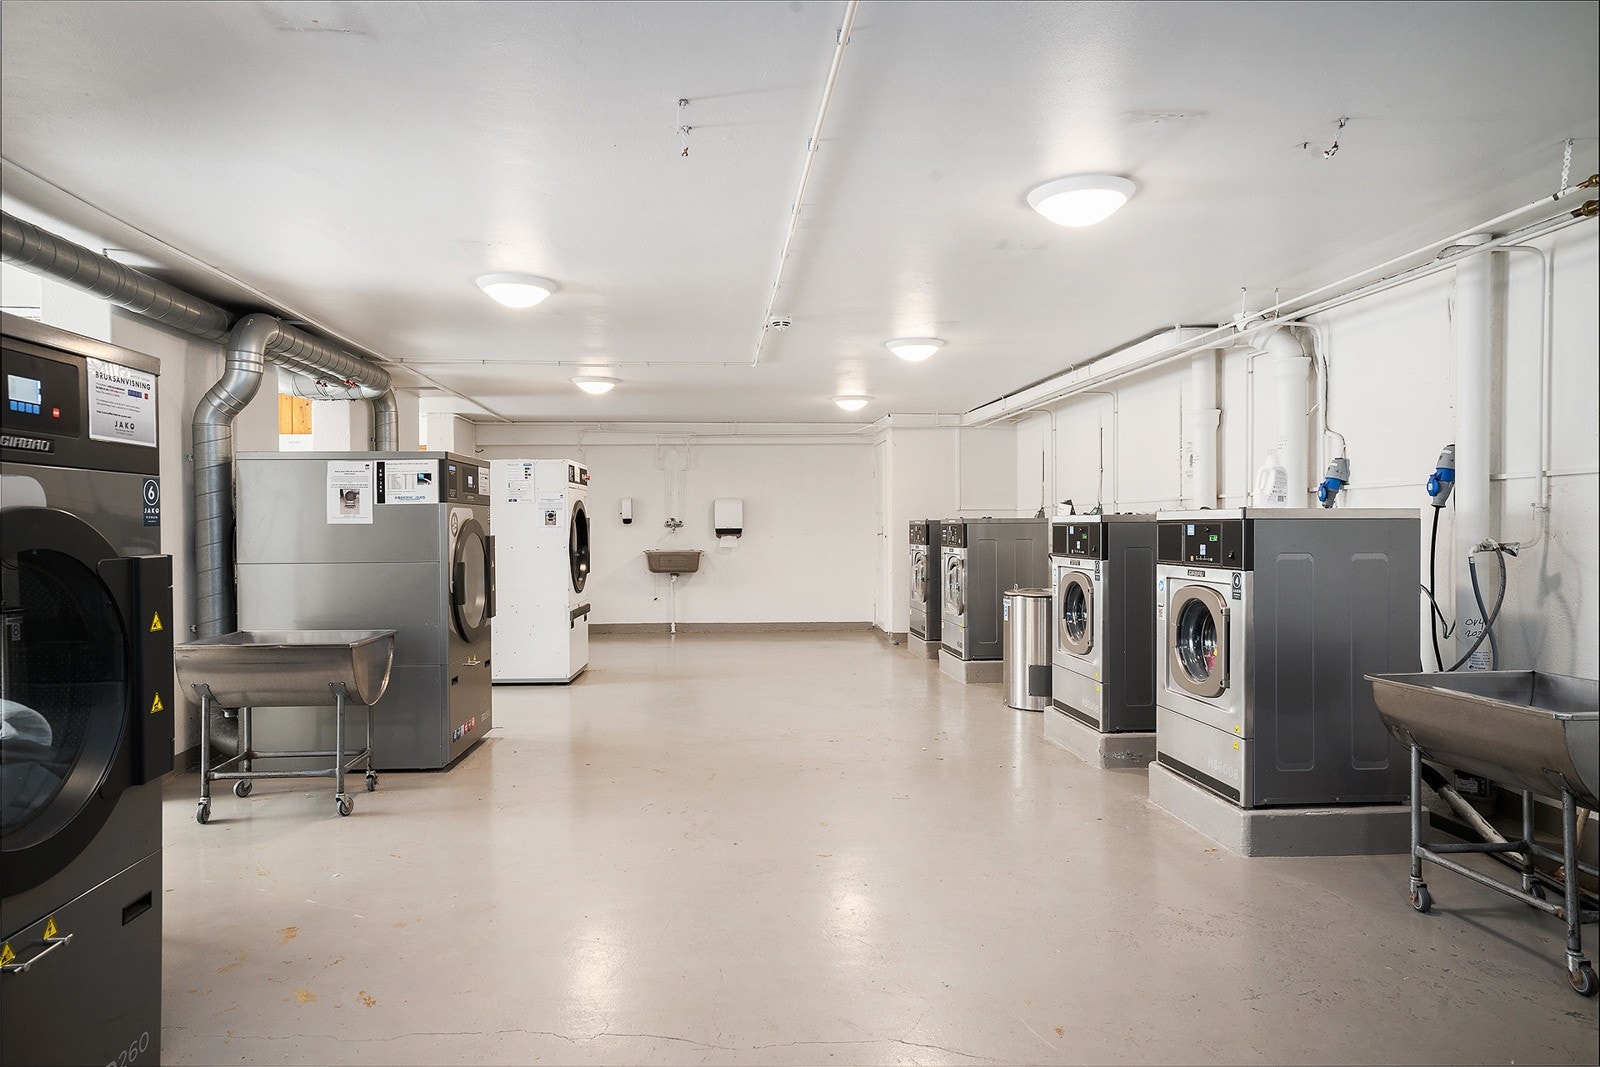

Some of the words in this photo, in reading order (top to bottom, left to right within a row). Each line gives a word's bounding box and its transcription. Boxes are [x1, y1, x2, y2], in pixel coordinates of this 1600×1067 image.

[95, 371, 151, 391] BRUKSANVISNING
[115, 421, 135, 430] JAKO
[148, 486, 155, 500] 6
